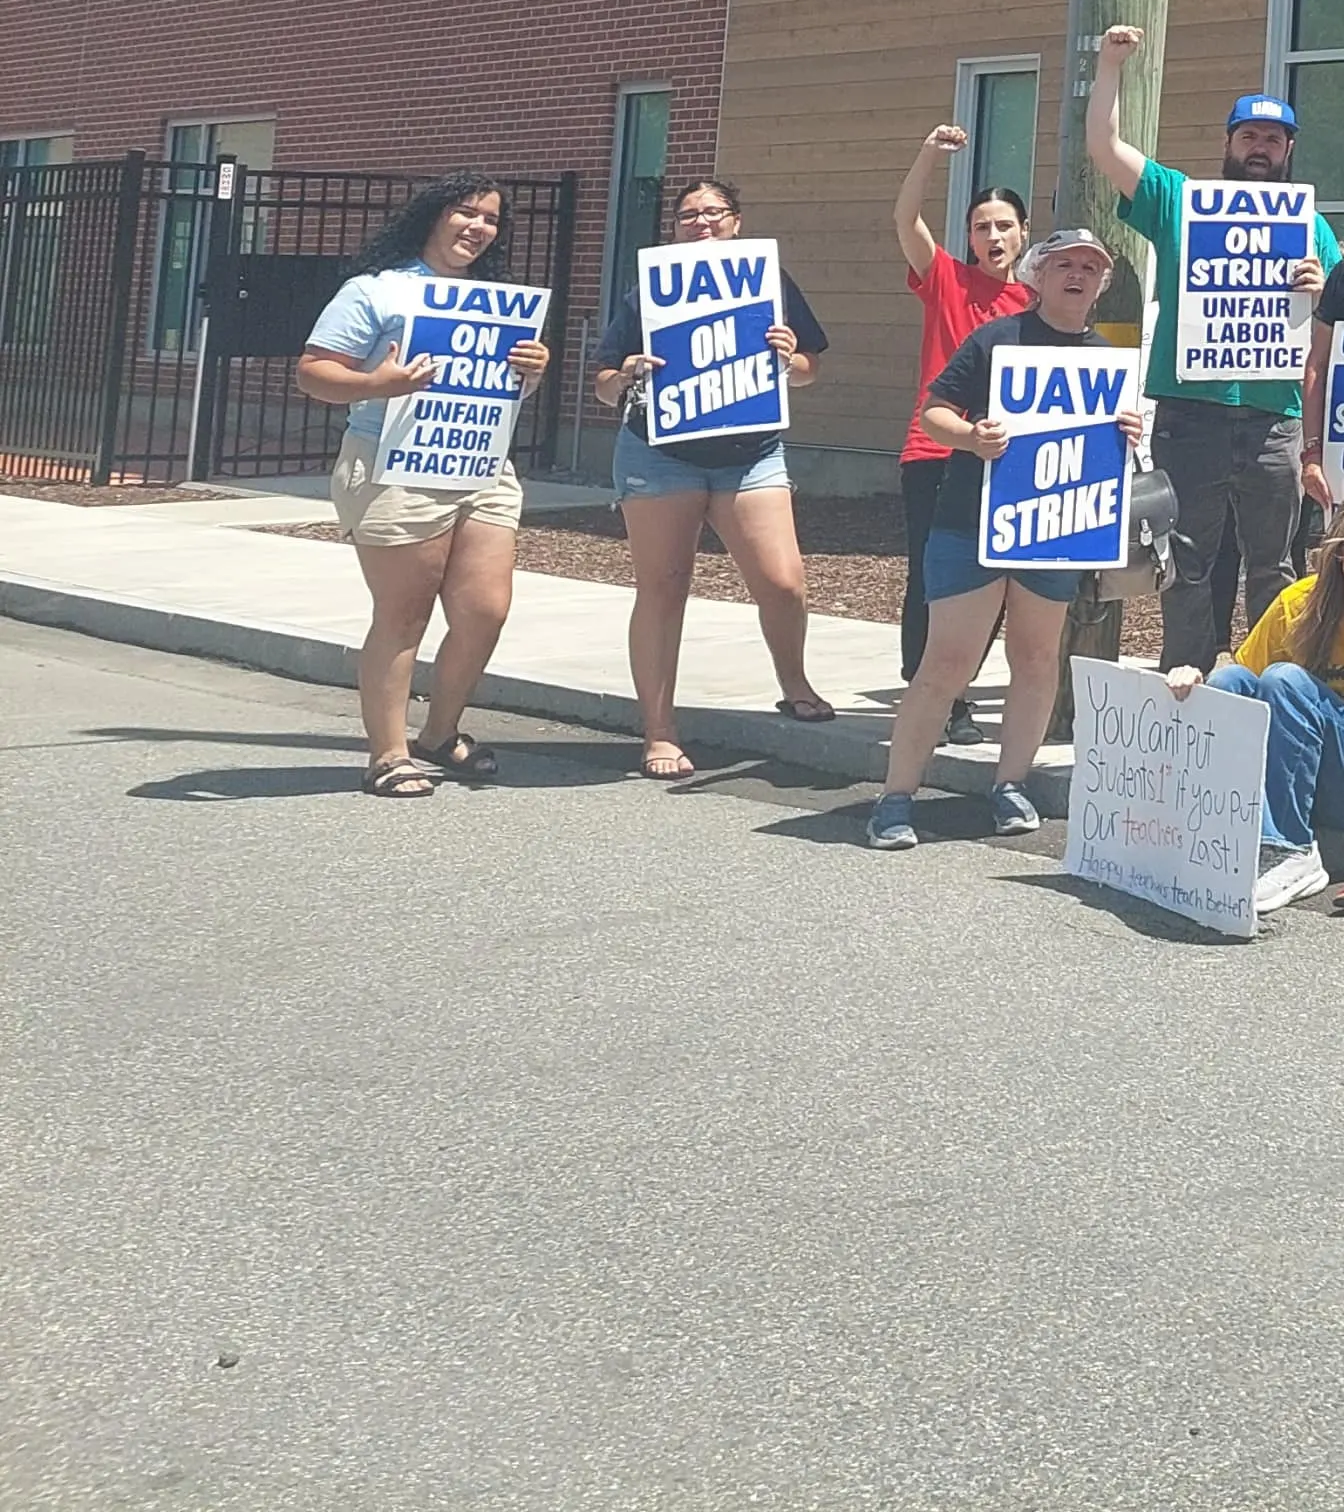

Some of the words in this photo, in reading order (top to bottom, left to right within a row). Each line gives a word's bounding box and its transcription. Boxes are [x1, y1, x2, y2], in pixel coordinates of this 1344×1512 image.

[1191, 189, 1307, 216] UAW
[1225, 226, 1271, 254] ON
[649, 256, 767, 307] UAW
[423, 284, 543, 319] UAW
[1203, 297, 1290, 318] UNFAIR
[451, 323, 500, 356] ON
[690, 316, 737, 369] ON
[1206, 323, 1285, 344] LABOR
[1186, 348, 1303, 369] PRACTICE
[659, 350, 775, 430] STRIKE
[1000, 366, 1128, 415] UAW
[414, 399, 503, 427] UNFAIR
[413, 425, 492, 452] LABOR
[386, 449, 500, 478] PRACTICE
[1034, 434, 1085, 490] ON
[991, 478, 1118, 553] STRIKE
[1086, 748, 1156, 803] Students
[1175, 768, 1189, 811] if
[1083, 800, 1121, 841] Our
[1078, 841, 1124, 883] Happy
